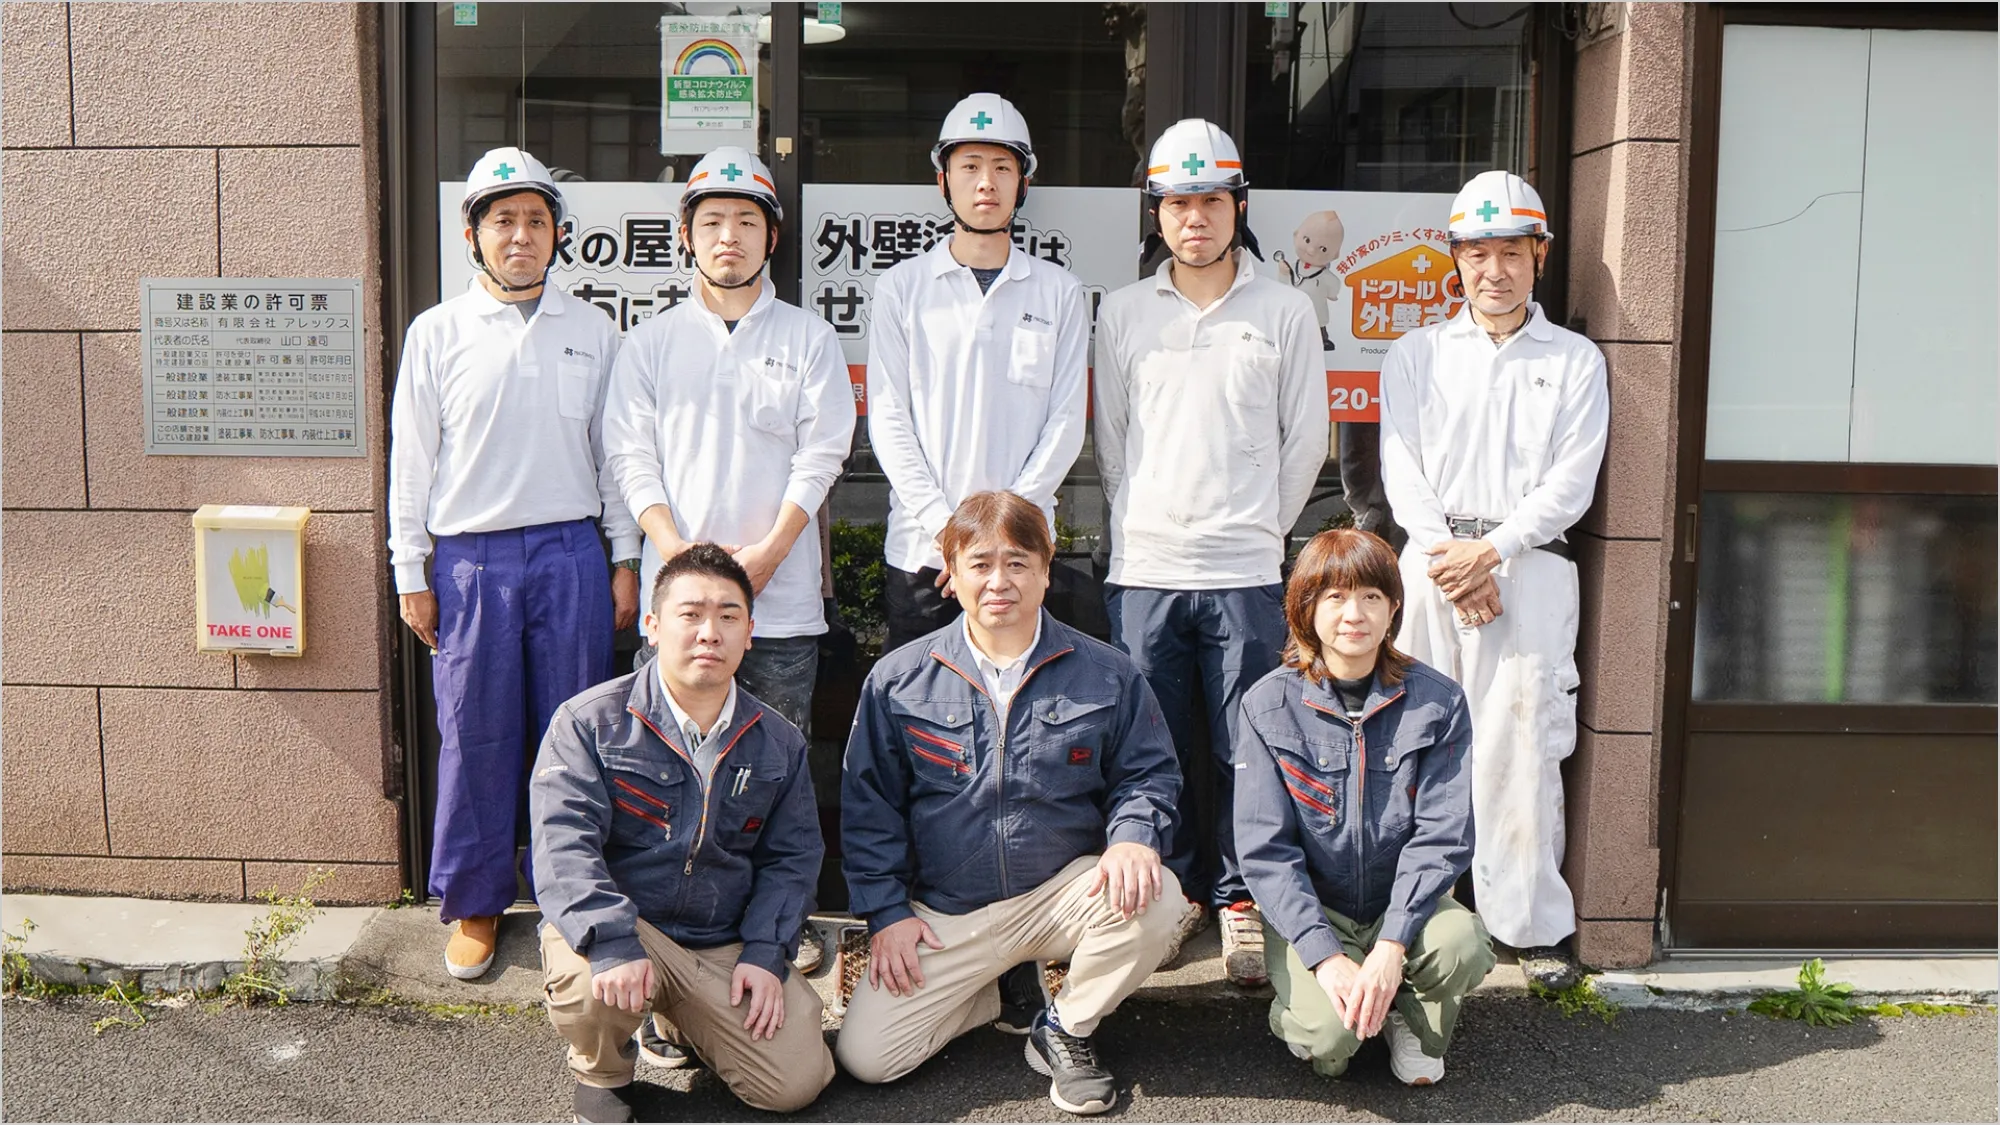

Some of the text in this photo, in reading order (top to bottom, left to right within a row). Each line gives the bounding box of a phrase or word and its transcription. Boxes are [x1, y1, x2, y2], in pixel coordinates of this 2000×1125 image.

[674, 80, 747, 89] 新型コロナウイルス
[679, 90, 742, 99] 感染拡大防止中
[817, 219, 1065, 270] 外壁は
[1360, 279, 1436, 299] ドクトル
[176, 293, 329, 311] 建設業の許可票
[154, 318, 209, 328] 商号又は名称
[218, 318, 350, 329] 有限会社 アレックス
[153, 335, 209, 346] 代表者の氏名
[281, 336, 302, 346] 山口
[256, 355, 305, 365] 許可番号
[309, 355, 351, 366] 許可年月日
[156, 372, 208, 383] 一般建設業
[215, 373, 253, 383] 塗装工事業
[156, 390, 208, 400] 一般建設業
[215, 390, 253, 400] 防水工事業
[156, 407, 209, 418] 一般建設業
[207, 624, 292, 639] TAKE ONE
